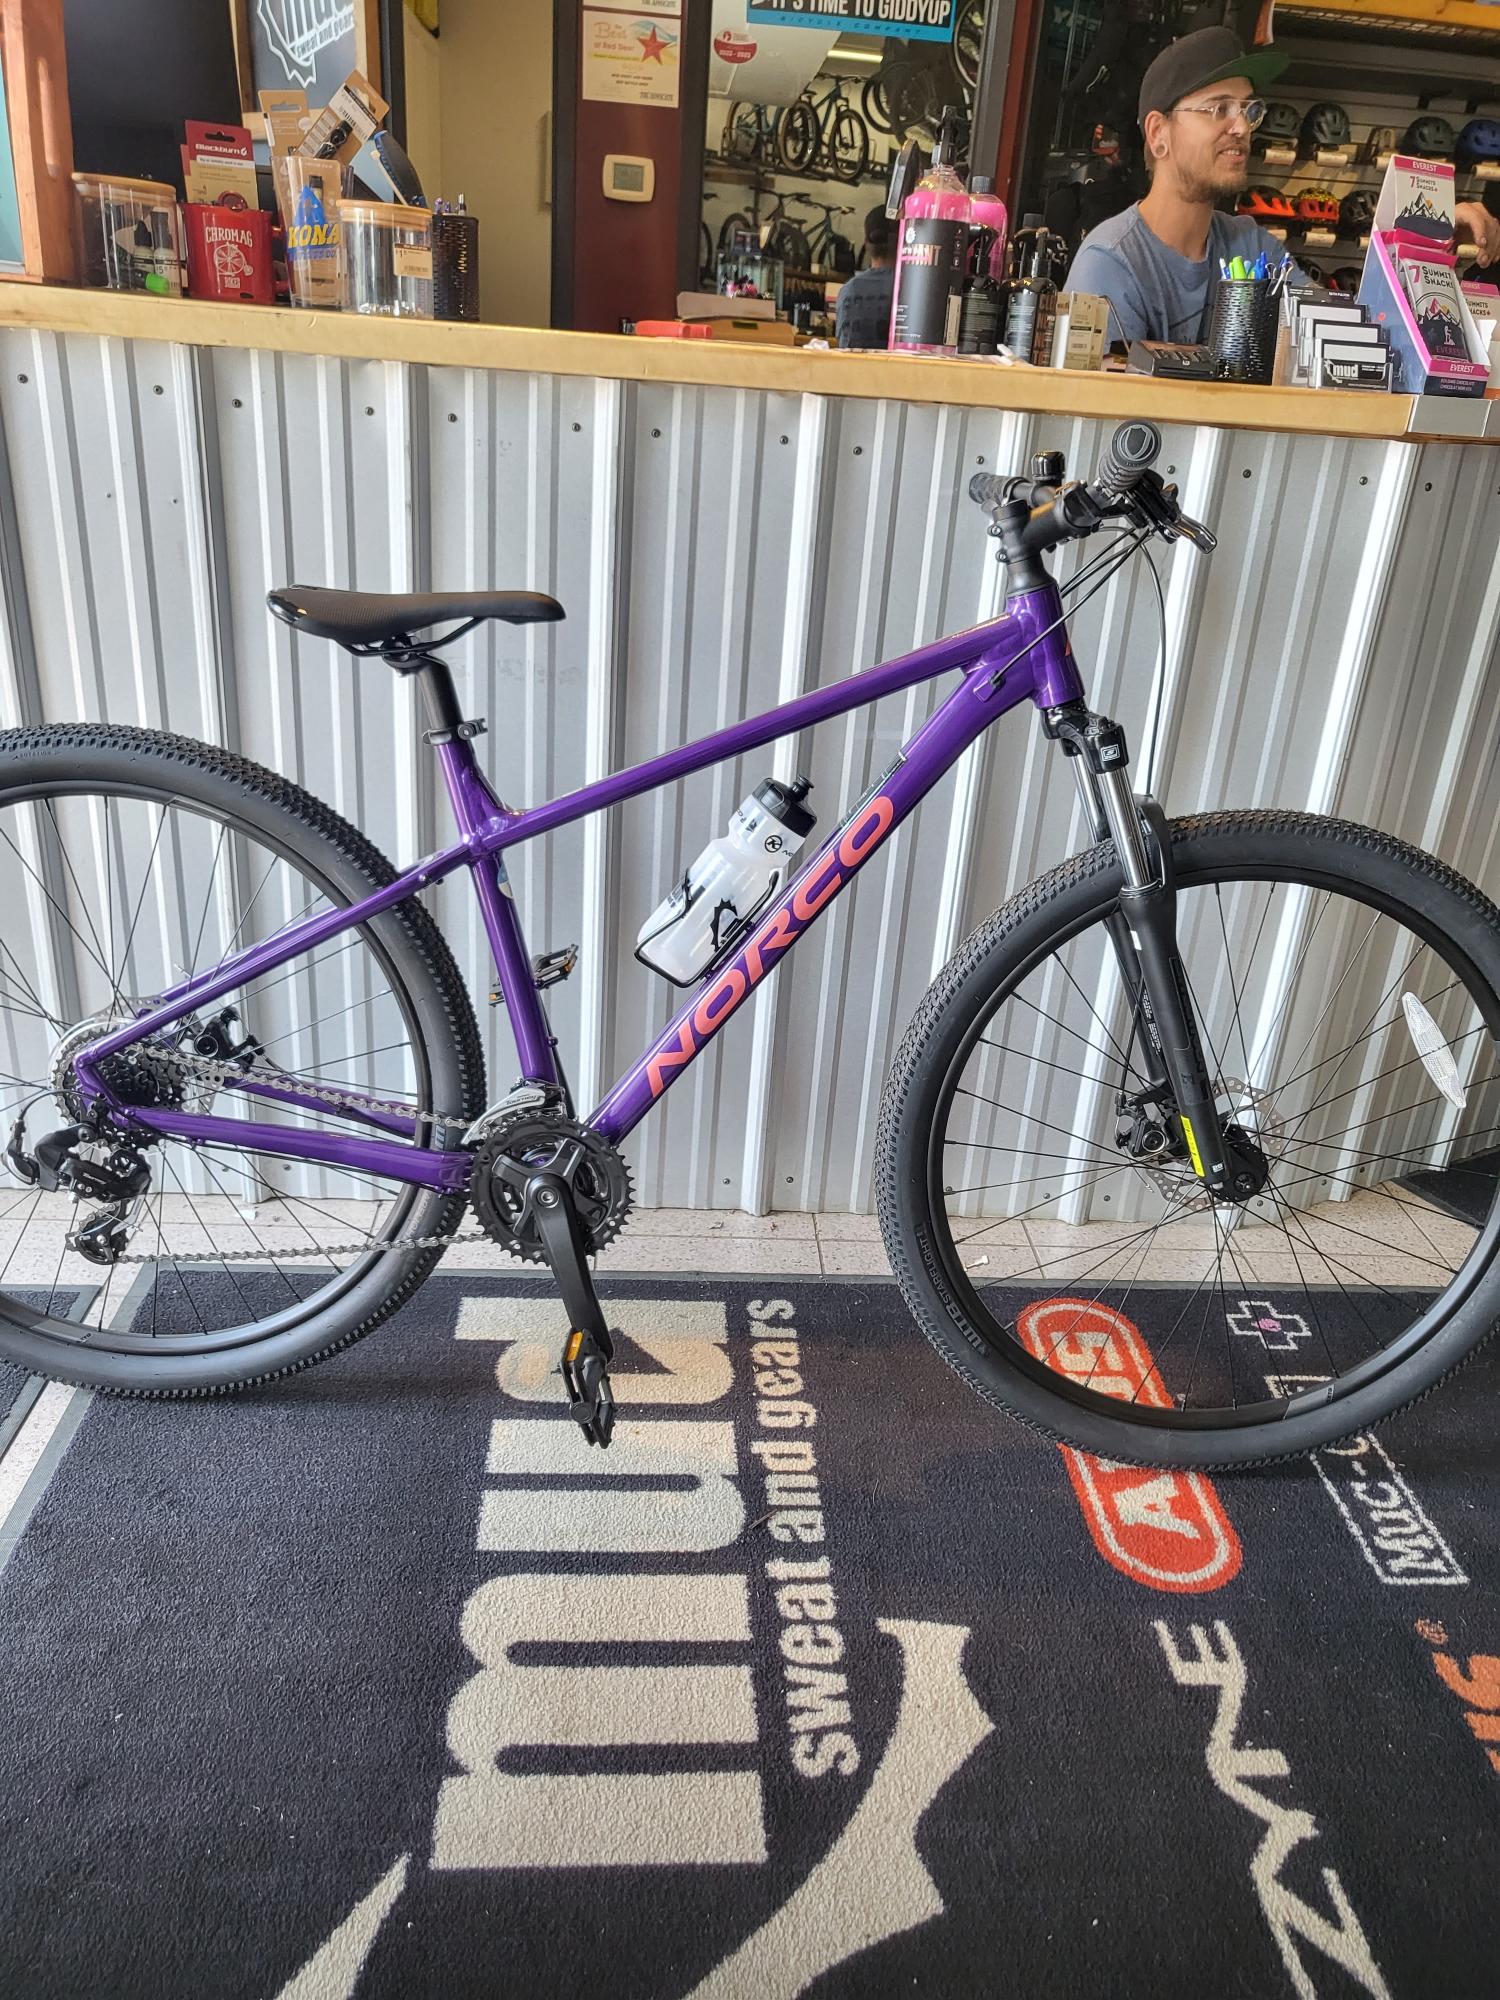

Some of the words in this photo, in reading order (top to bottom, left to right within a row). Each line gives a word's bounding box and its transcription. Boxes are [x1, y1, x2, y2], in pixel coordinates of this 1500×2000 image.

[855, 0, 874, 17] TO
[878, 0, 951, 25] GIDDYUP
[195, 143, 240, 155] Blackburn
[1412, 161, 1437, 173] EVEREST
[1410, 175, 1416, 188] 7
[205, 225, 253, 247] CHROMAG
[287, 223, 340, 249] KONA
[1408, 265, 1420, 283] 7
[1421, 265, 1451, 280] SUMMIT
[1466, 298, 1489, 309] UMMITS
[1332, 364, 1359, 378] mud
[1450, 363, 1475, 374] EVEREST
[645, 795, 894, 1098] NORCO
[919, 1236, 951, 1305] STARFLIGHT
[747, 1298, 818, 1430] gears
[1052, 1330, 1202, 1540] AS
[750, 1439, 827, 1544] and
[430, 1297, 769, 1869] mud
[766, 1553, 861, 1779] sweat
